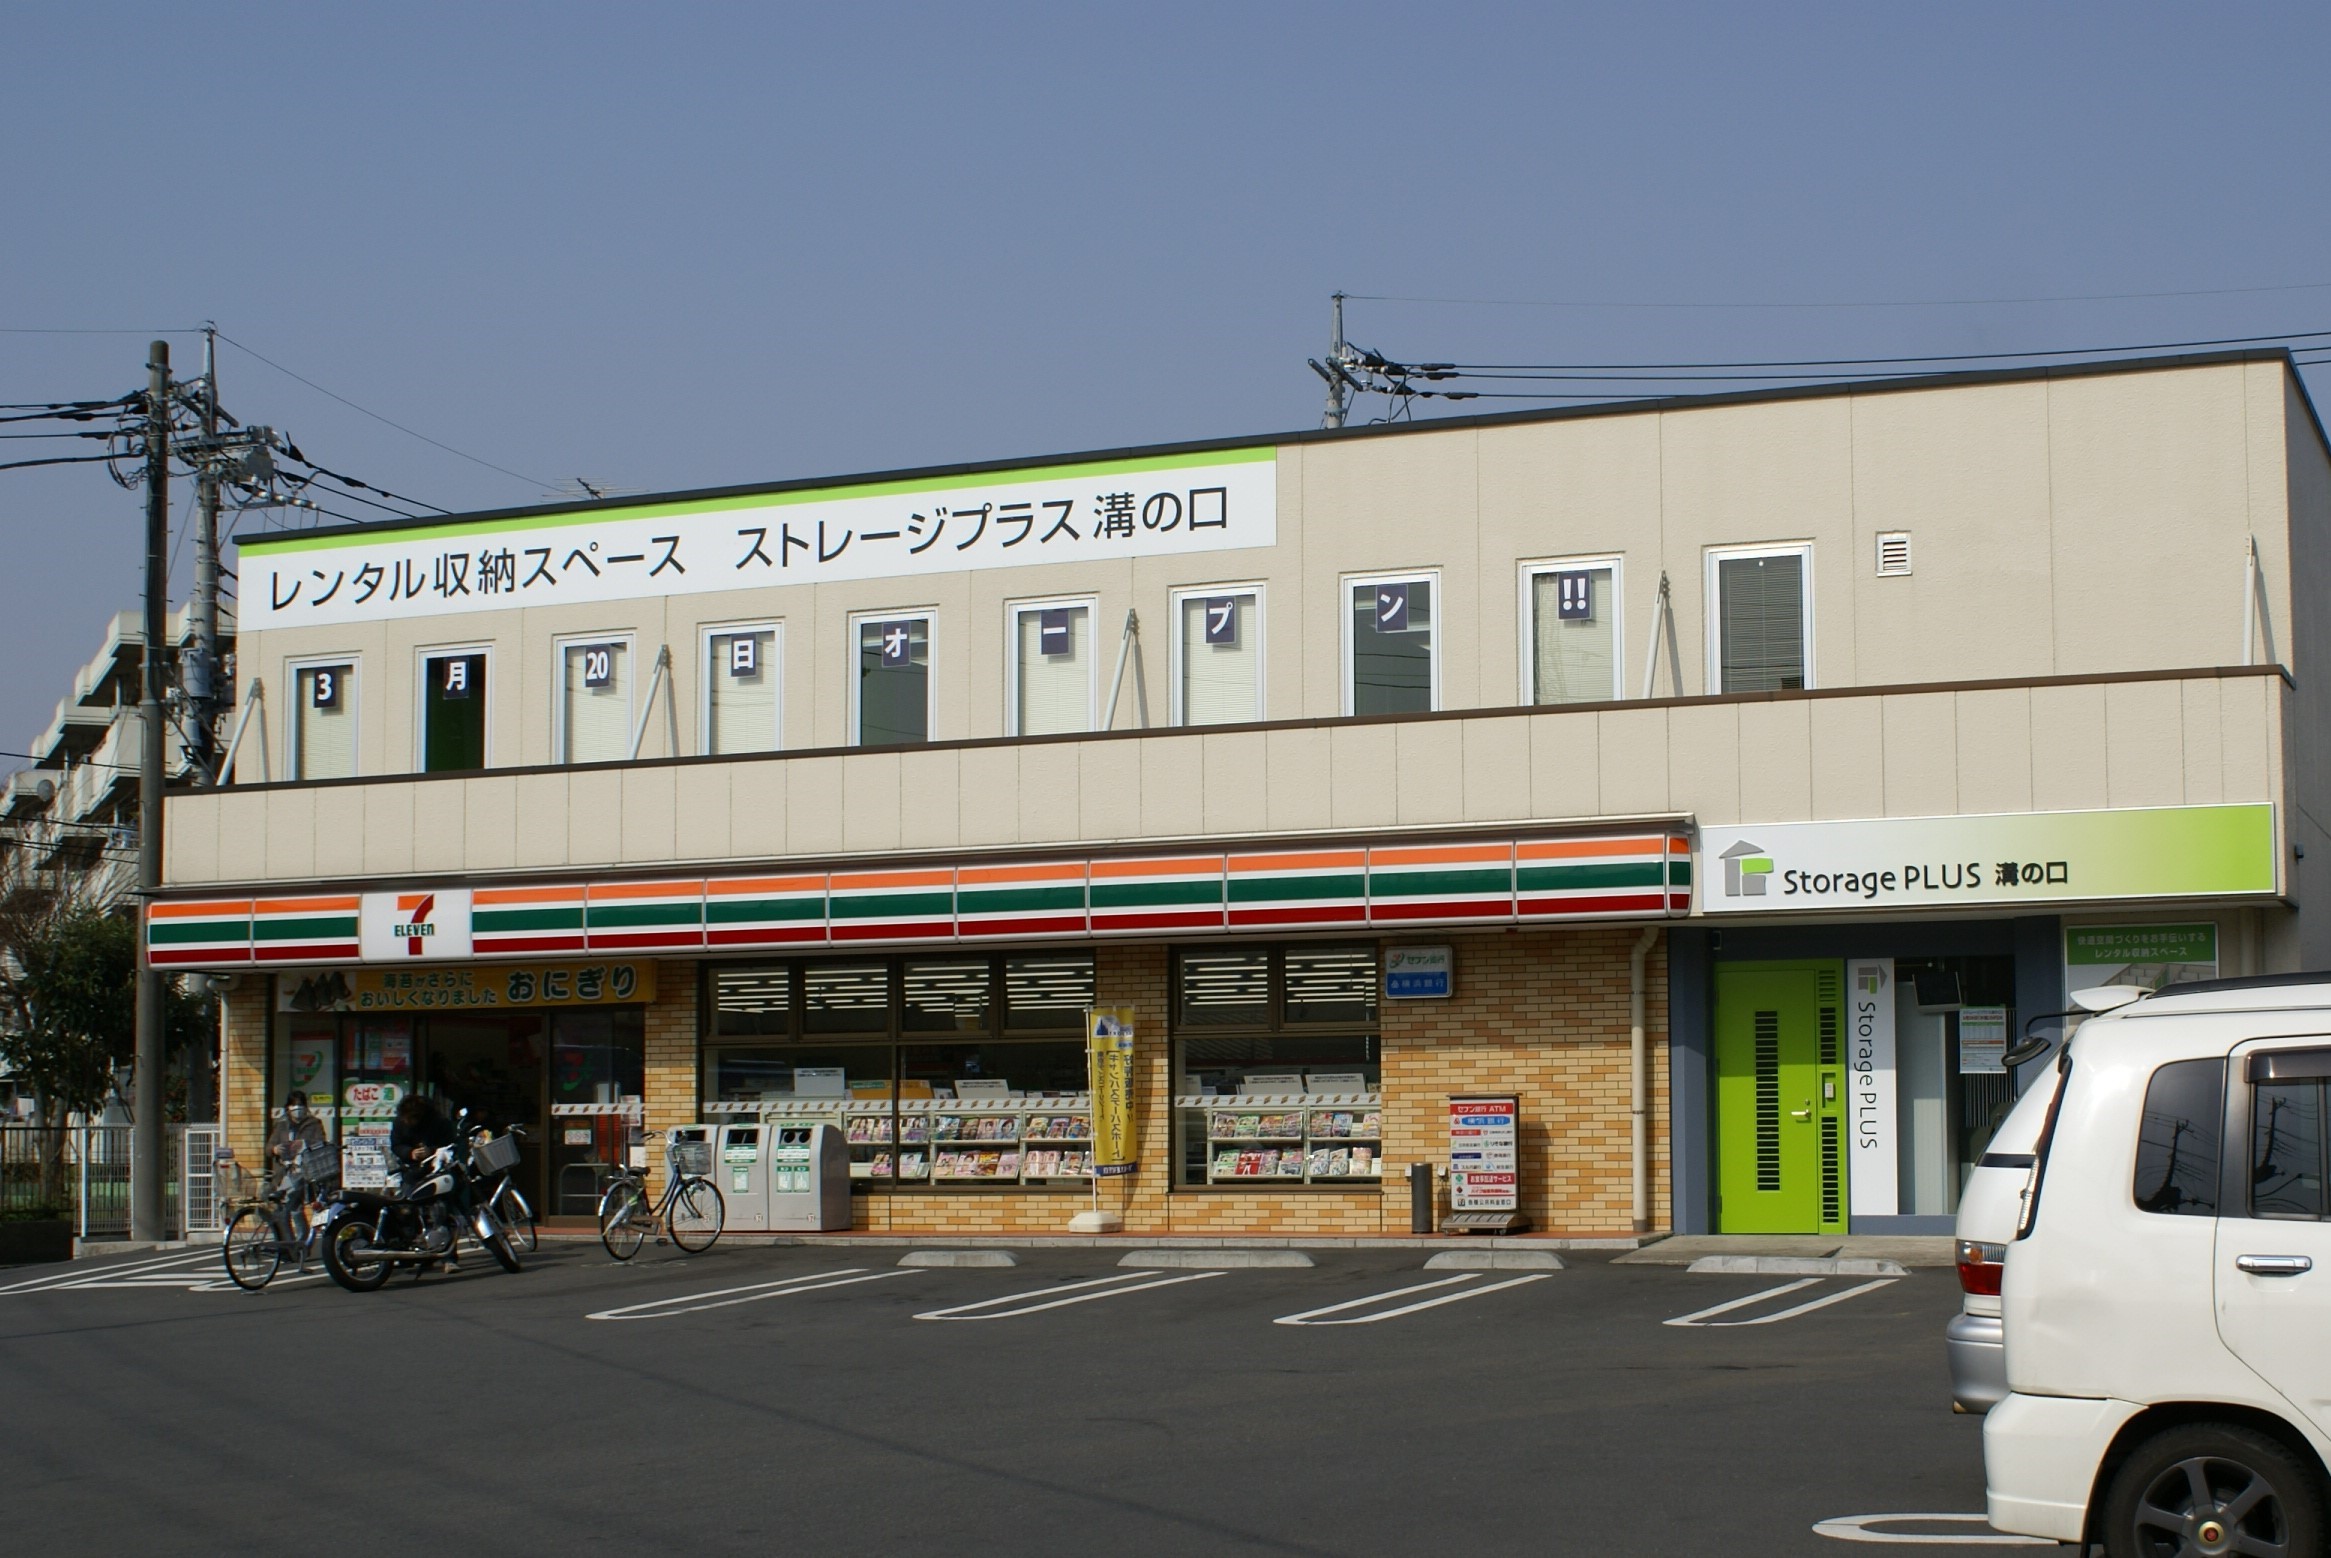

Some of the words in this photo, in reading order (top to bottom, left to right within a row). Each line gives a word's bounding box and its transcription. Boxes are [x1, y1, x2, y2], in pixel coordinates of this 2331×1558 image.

[270, 535, 686, 611] レンタル収納スペース
[736, 499, 1080, 570] ストレージプラス
[1092, 486, 1228, 540] 溝の口
[1783, 869, 1896, 899] Storage
[1904, 862, 1982, 890] PLUS
[1995, 860, 2068, 887] 溝の口
[2094, 947, 2188, 959] レンタル収納スペース
[383, 970, 474, 990] 海苔がさらに
[506, 964, 638, 1001] おにぎり
[359, 987, 498, 1008] おいしくなりました
[1854, 1001, 1876, 1086] Storage
[353, 1086, 379, 1101] たばこ
[1488, 1105, 1507, 1113] ATM
[1859, 1092, 1878, 1149] PLUS
